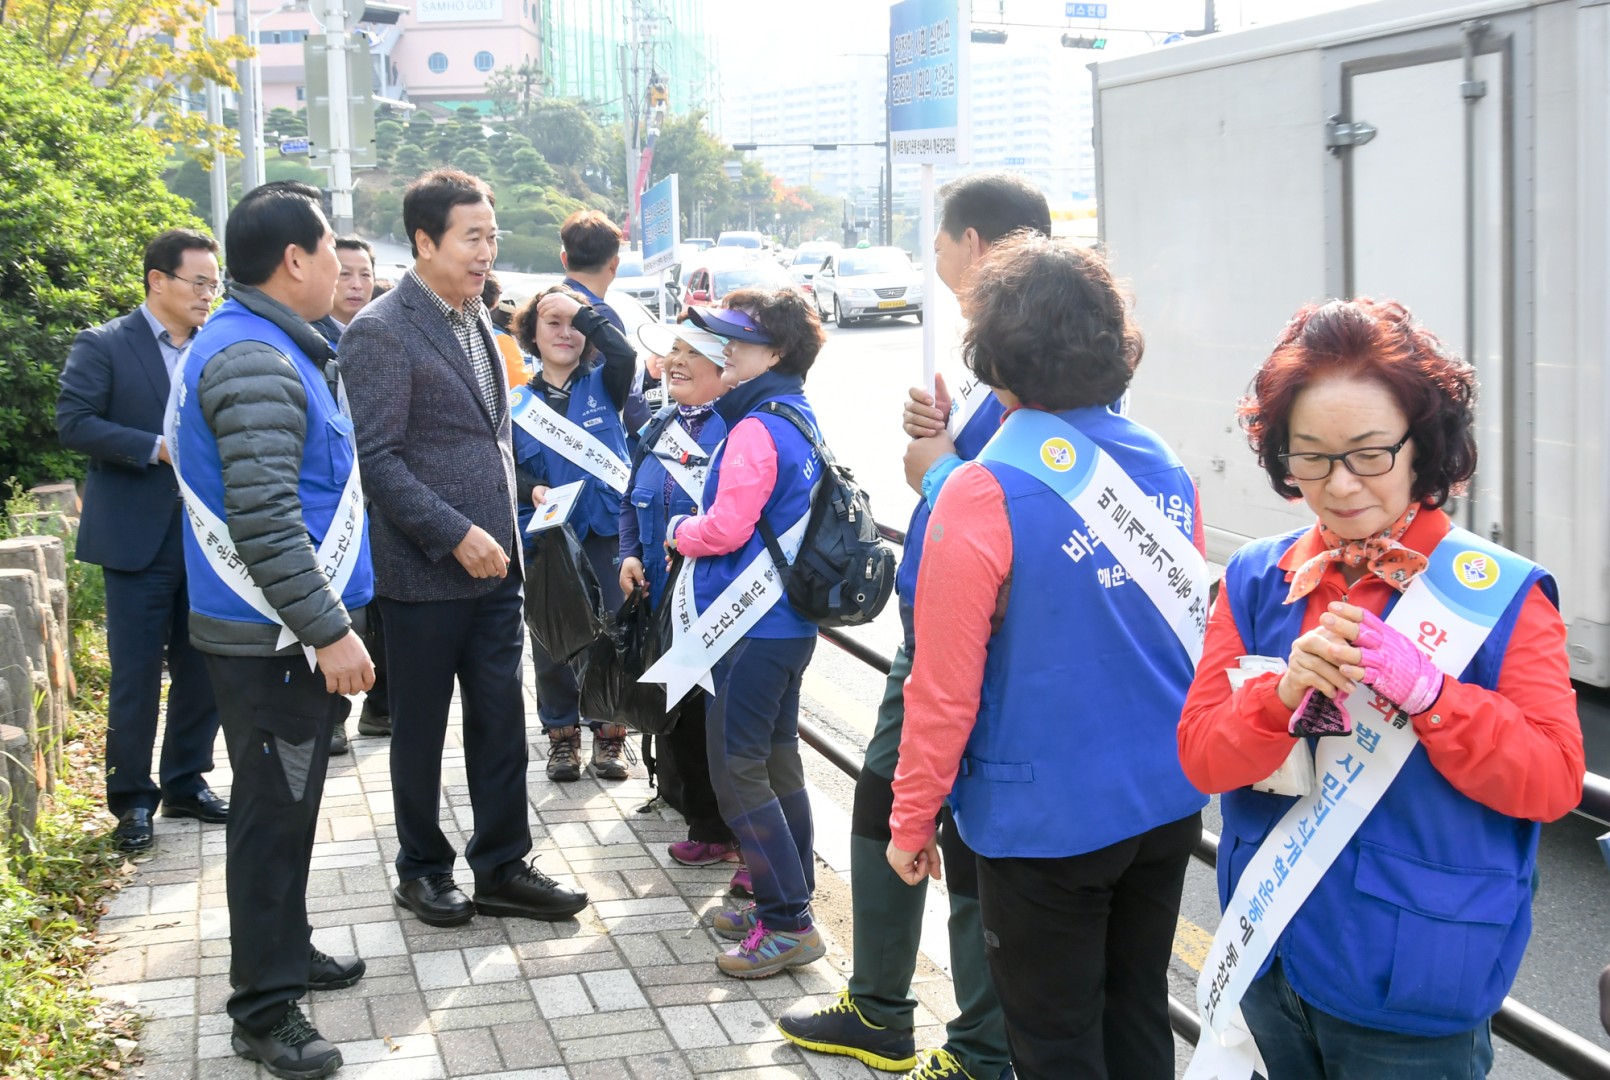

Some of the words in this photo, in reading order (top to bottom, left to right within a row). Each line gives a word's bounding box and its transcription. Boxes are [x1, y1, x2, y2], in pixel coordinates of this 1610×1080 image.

[422, 1, 464, 12] SAMHO
[467, 0, 495, 10] GOLF
[1066, 4, 1105, 17] 버스전용
[934, 63, 955, 97] 첫걸음
[1097, 486, 1192, 599] 바르게살기운동
[701, 579, 767, 649] 만들어갑시다
[1204, 940, 1239, 1026] 동참합시
